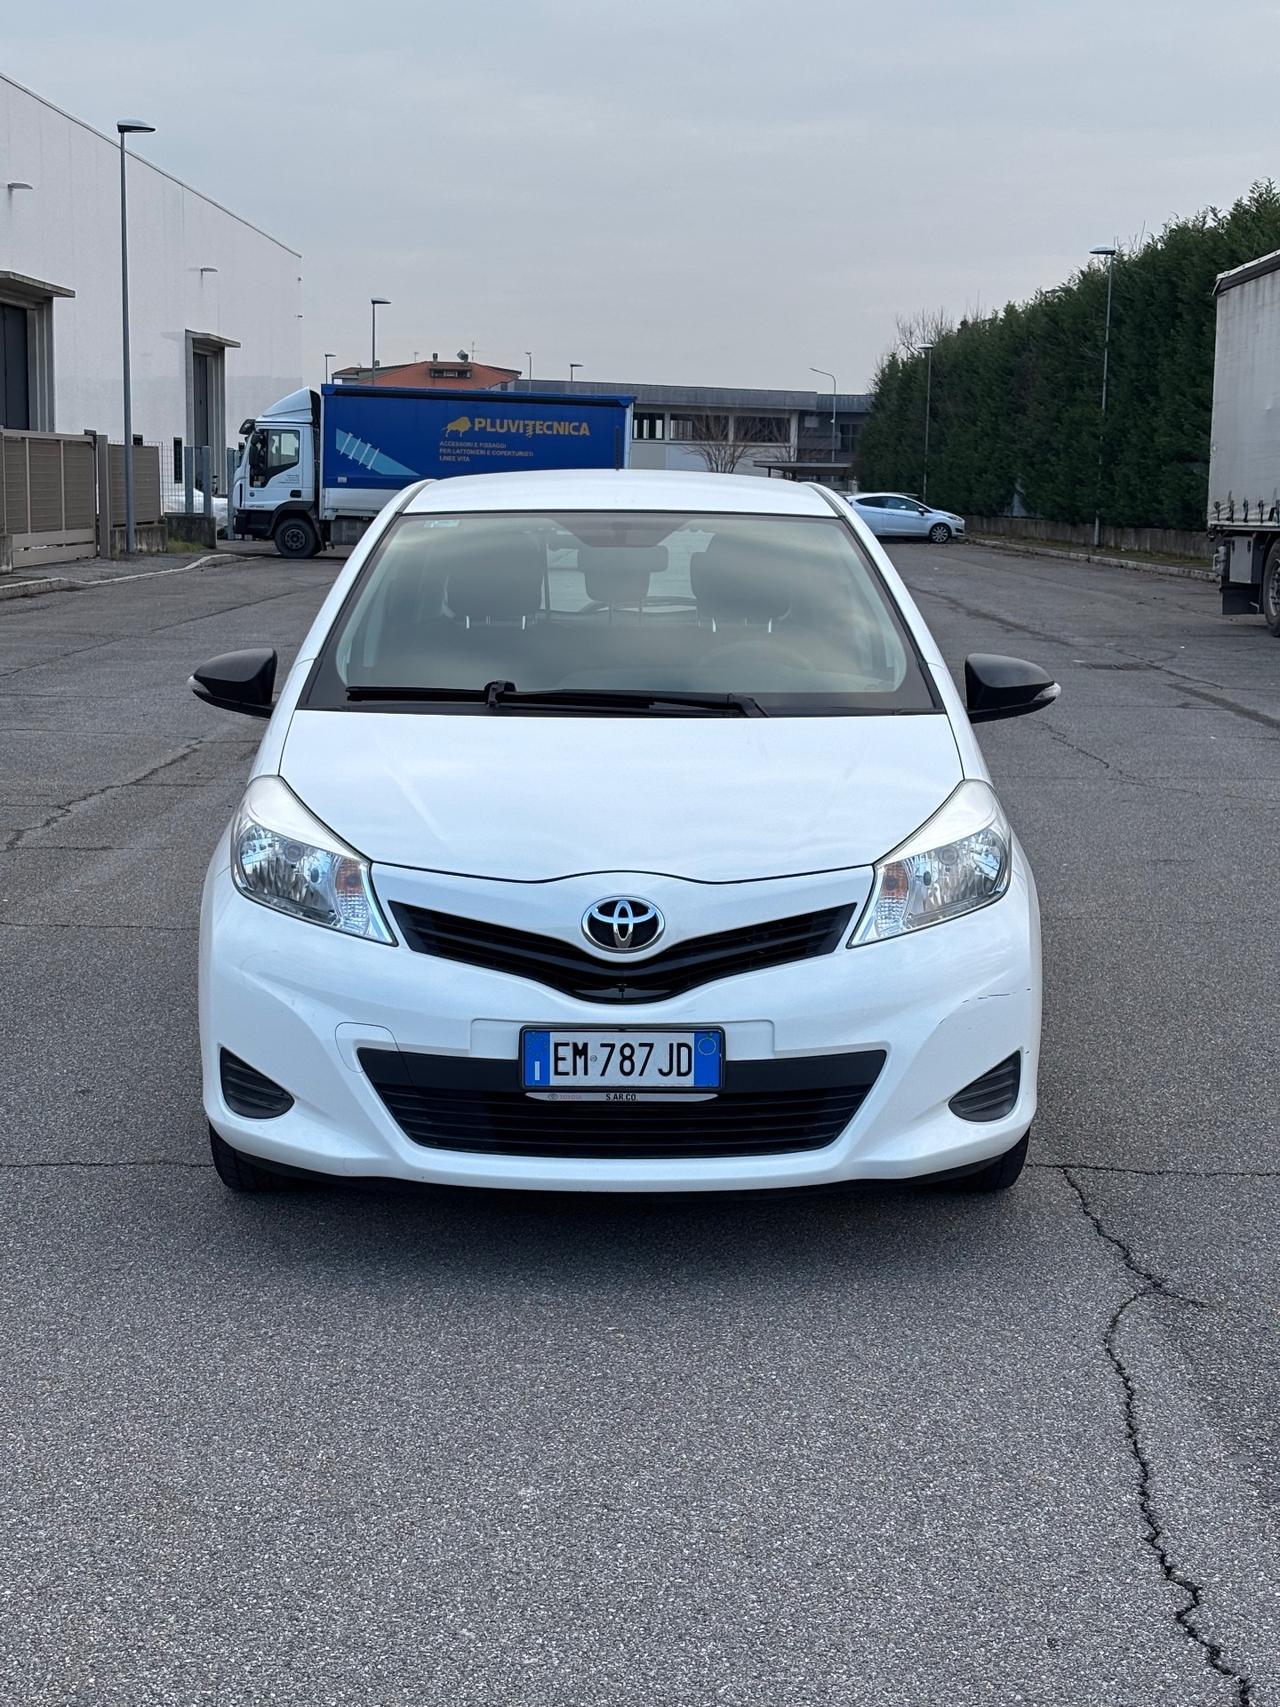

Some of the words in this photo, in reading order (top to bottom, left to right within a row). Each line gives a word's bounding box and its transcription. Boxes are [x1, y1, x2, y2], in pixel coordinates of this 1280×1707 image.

[474, 417, 590, 437] PLUVITECNICA
[553, 1042, 589, 1076] EM
[534, 1061, 541, 1081] I
